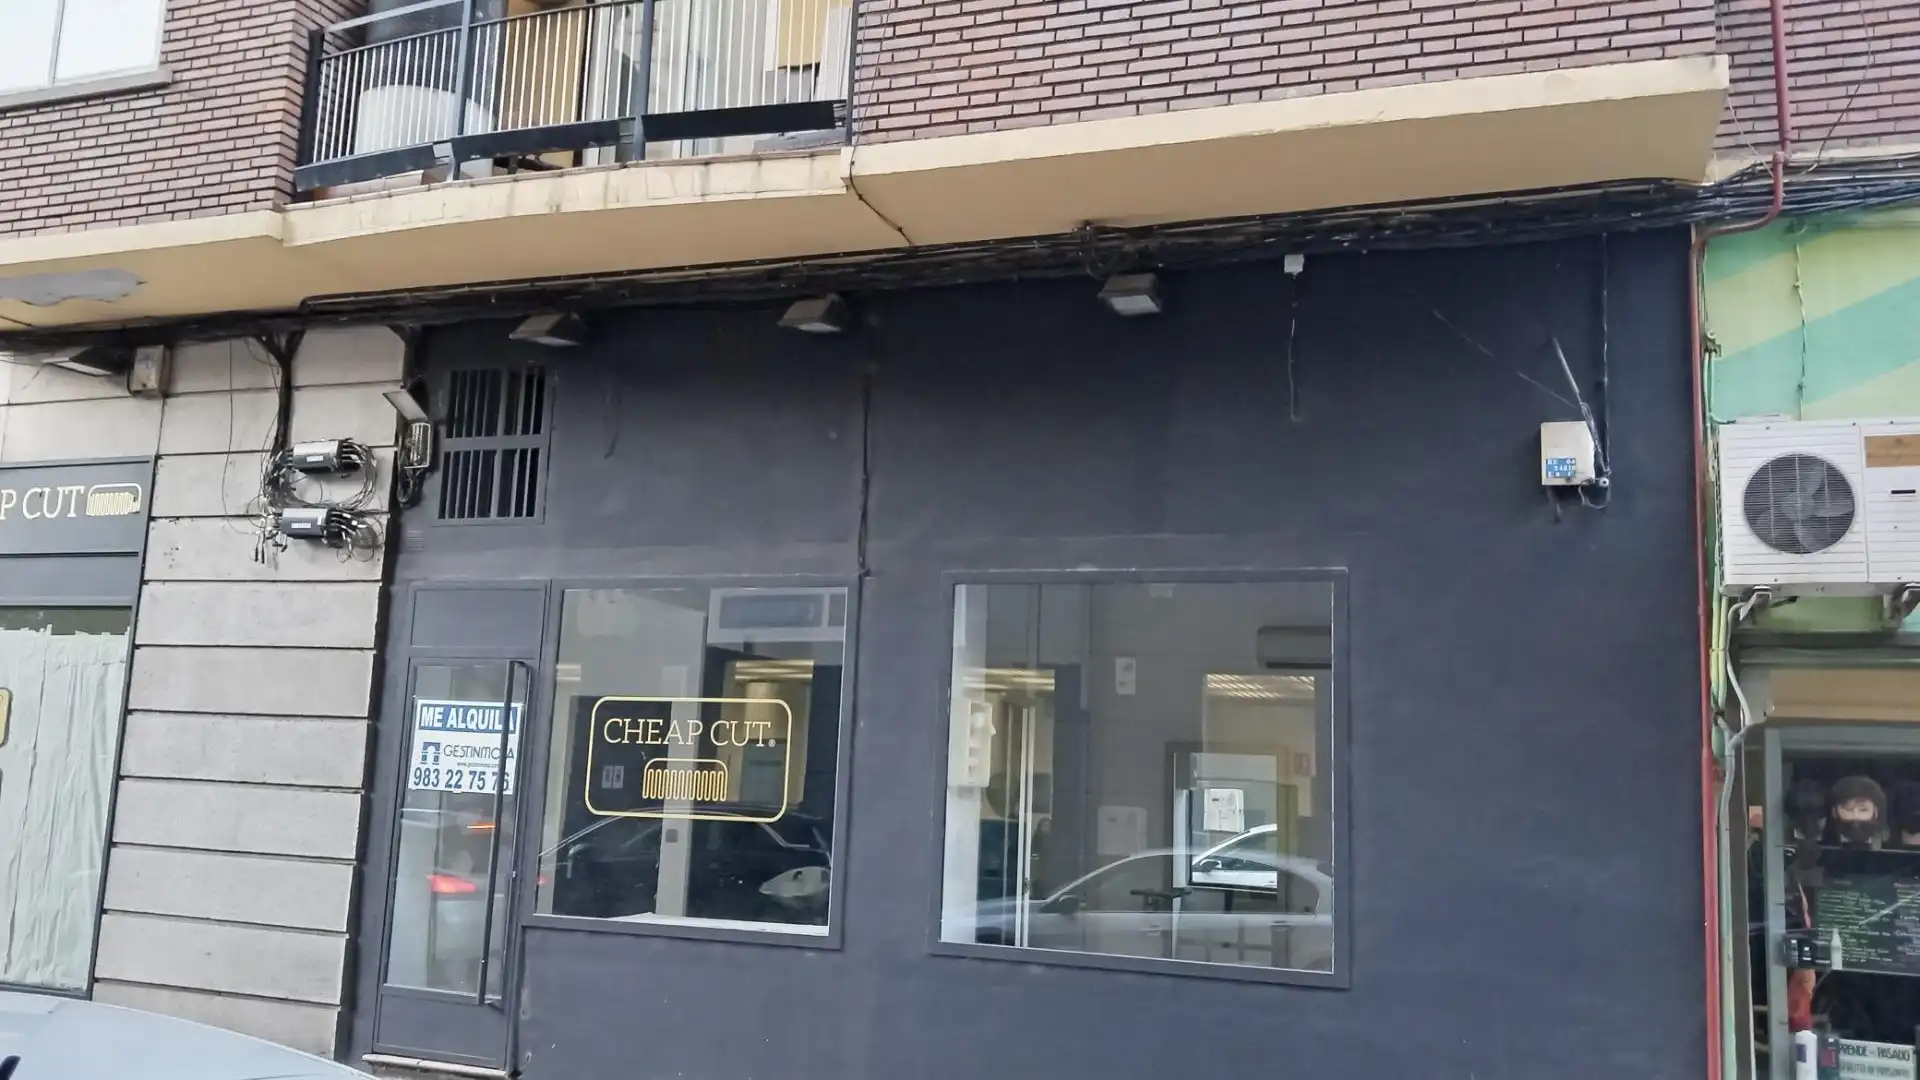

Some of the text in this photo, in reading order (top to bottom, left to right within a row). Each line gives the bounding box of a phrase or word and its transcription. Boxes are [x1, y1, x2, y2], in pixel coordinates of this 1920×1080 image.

[22, 486, 86, 519] CUT
[420, 706, 445, 728] ME
[603, 718, 704, 745] CHEAP
[443, 744, 515, 760] GESTINMOA
[413, 766, 440, 788] 983
[444, 769, 463, 789] 22
[468, 770, 486, 791] 75
